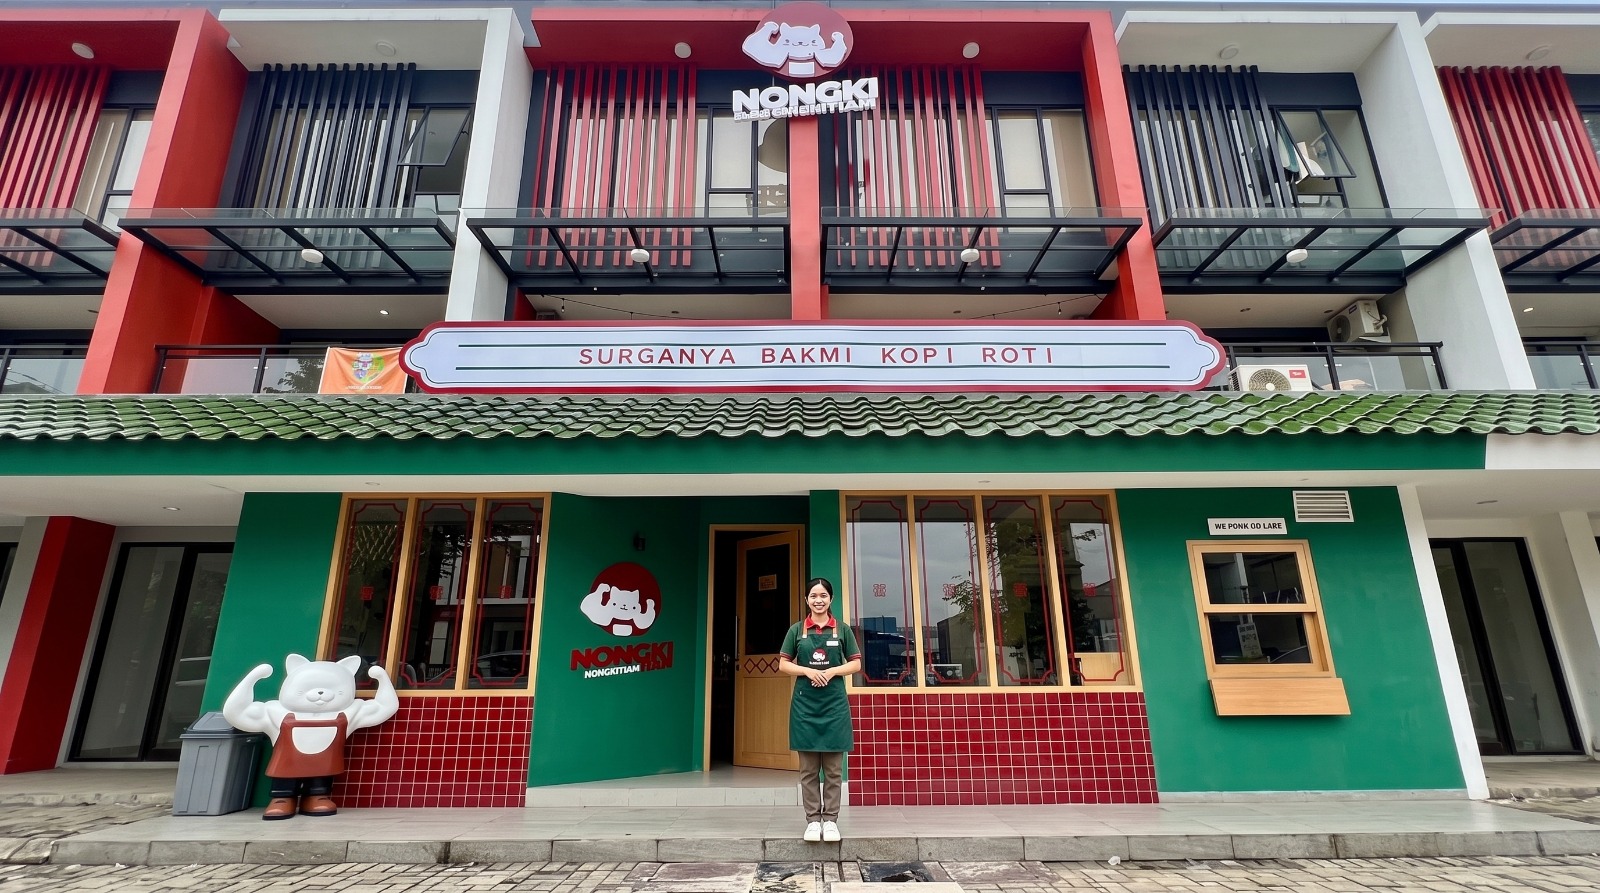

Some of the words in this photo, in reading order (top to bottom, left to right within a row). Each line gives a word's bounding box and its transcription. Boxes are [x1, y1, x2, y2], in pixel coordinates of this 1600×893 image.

[732, 77, 879, 112] NONGKI
[578, 348, 736, 365] SURGANYA
[761, 347, 851, 364] BAKMI
[881, 347, 953, 364] KOPI
[981, 347, 1052, 364] ROTI
[1262, 522, 1283, 530] LARE
[570, 641, 674, 670] NONGKI
[584, 664, 641, 679] NONGKITIAM
